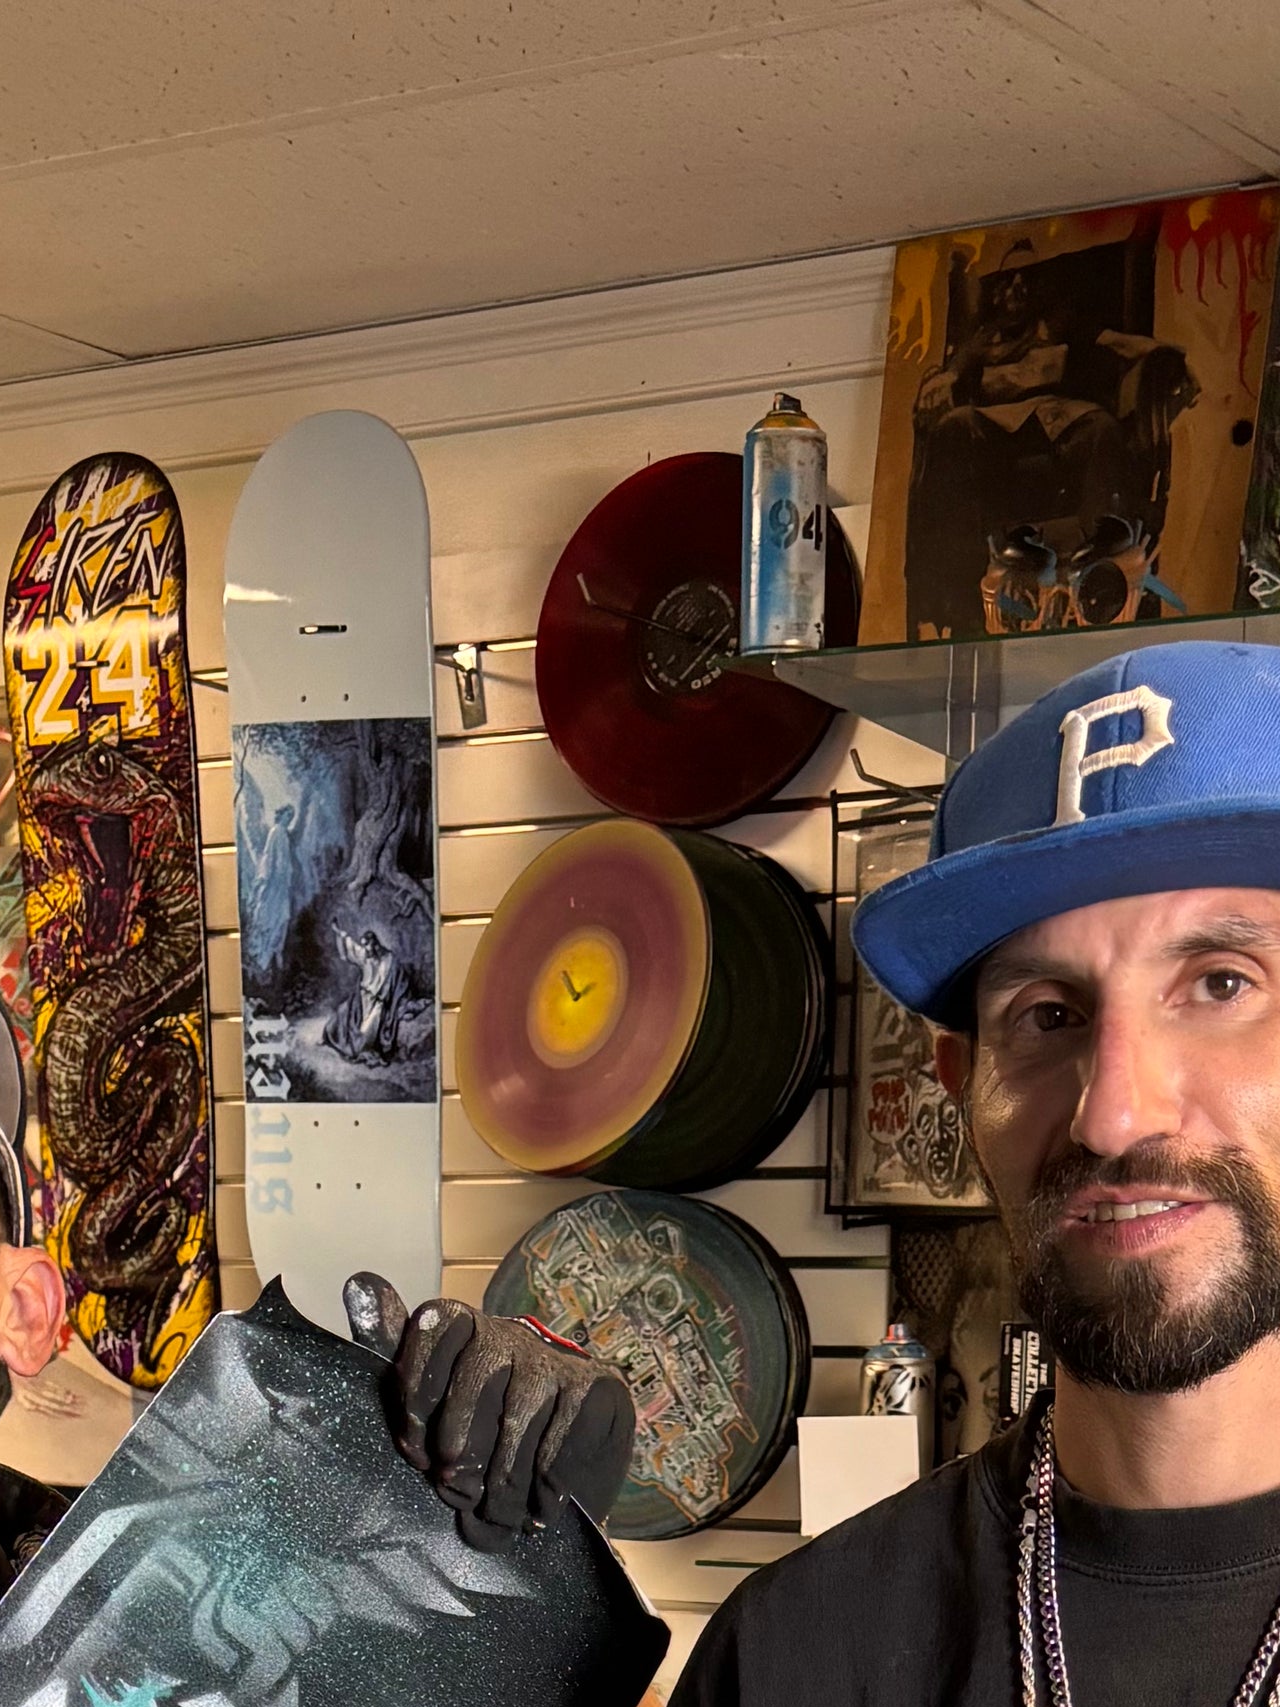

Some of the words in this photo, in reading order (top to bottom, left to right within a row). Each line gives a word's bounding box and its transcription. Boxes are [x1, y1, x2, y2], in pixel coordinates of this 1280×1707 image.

[770, 499, 824, 552] 94
[20, 607, 161, 745] 24
[1051, 685, 1175, 830] P
